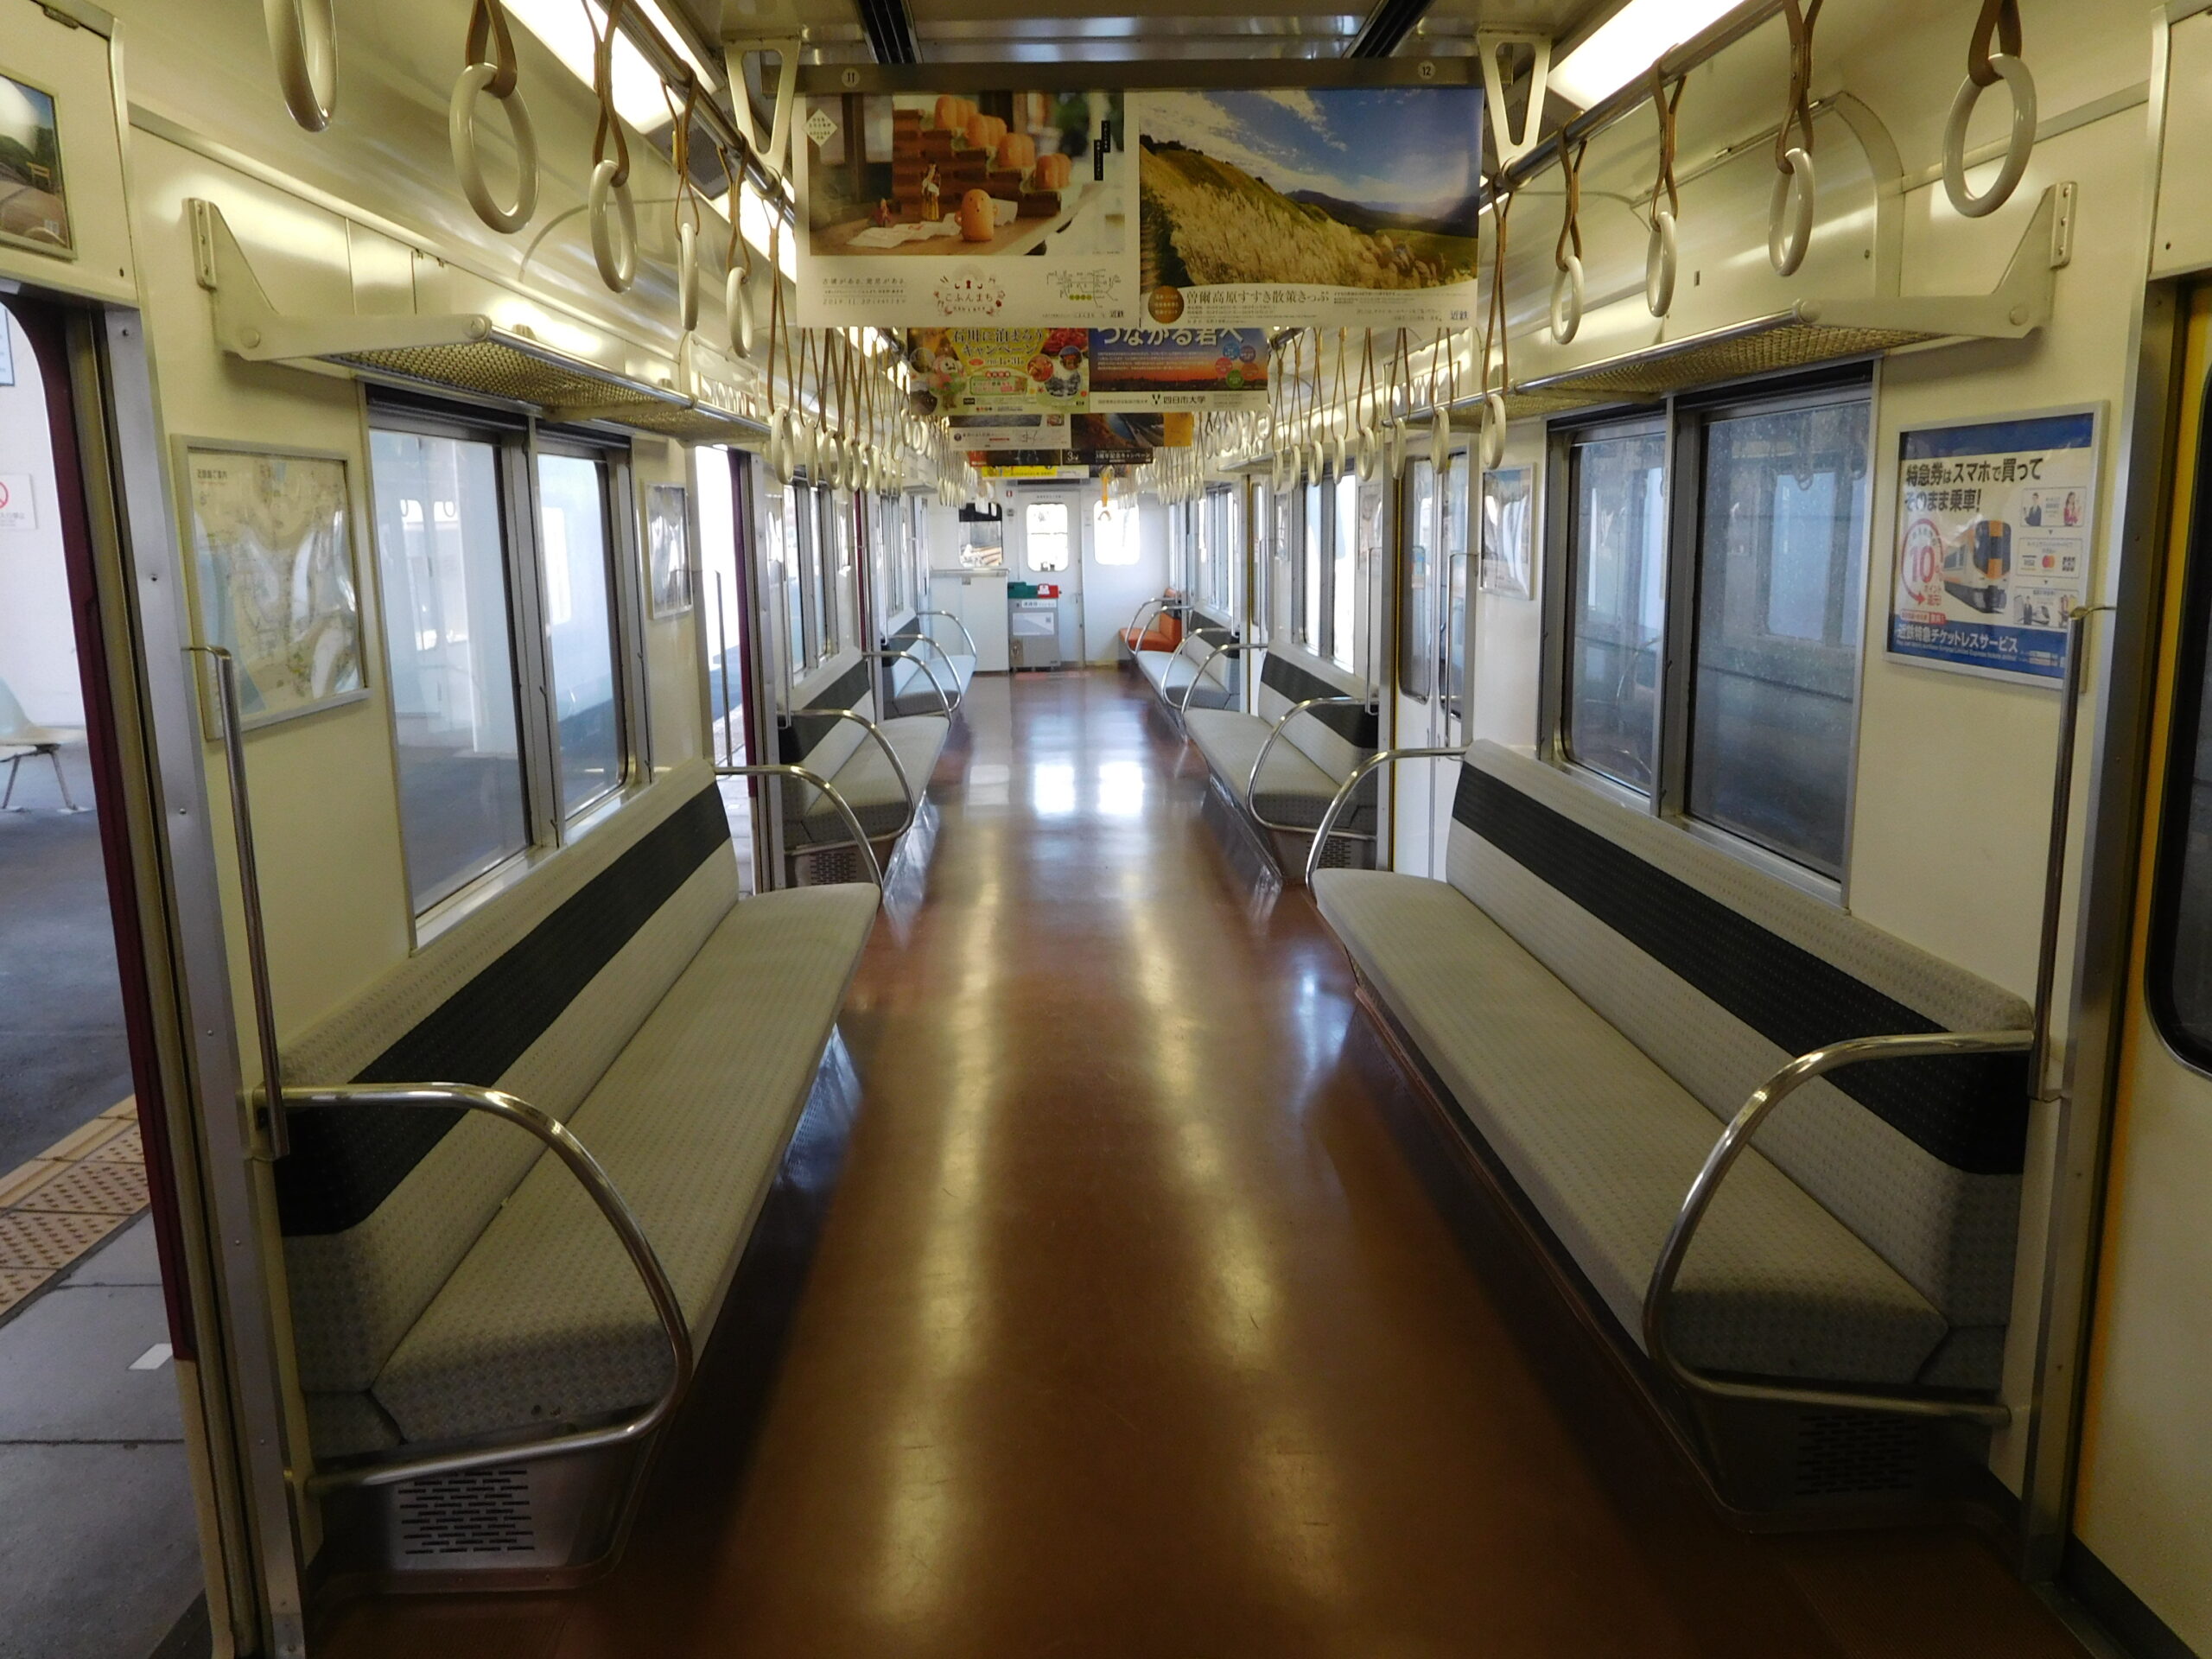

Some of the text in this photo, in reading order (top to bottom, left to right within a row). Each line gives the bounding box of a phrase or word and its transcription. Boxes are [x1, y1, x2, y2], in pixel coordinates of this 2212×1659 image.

[1422, 66, 1432, 76] 12
[847, 72, 855, 83] 11
[954, 328, 1043, 342] 石川に泊まろう
[963, 344, 1037, 356] キャンペーン
[1163, 394, 1206, 404] 四日市大学
[1905, 457, 2044, 487] 特急券はスマホで買って
[1897, 624, 2018, 653] 近鉄特急チケットレスサービス
